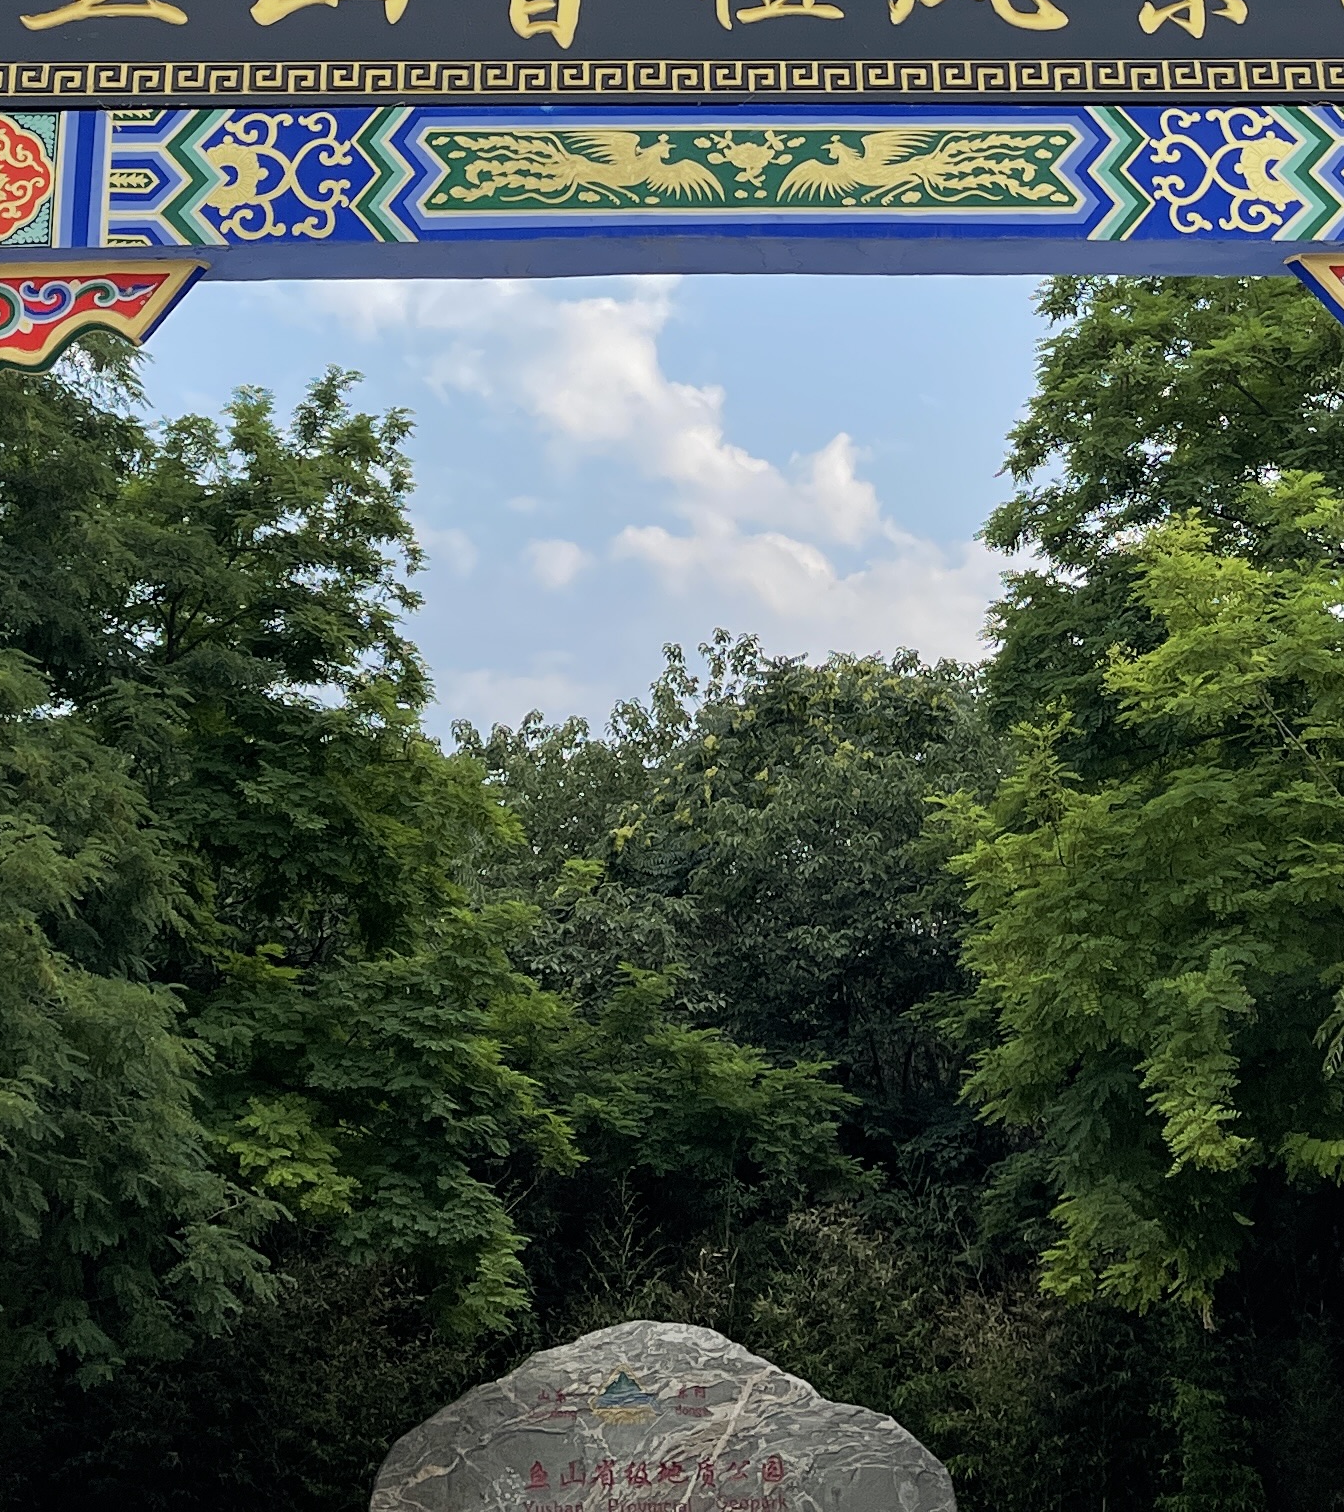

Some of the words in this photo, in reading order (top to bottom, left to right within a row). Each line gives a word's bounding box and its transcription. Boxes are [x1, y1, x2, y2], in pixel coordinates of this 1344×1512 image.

[524, 1454, 785, 1490] 鱼山省级地质公园
